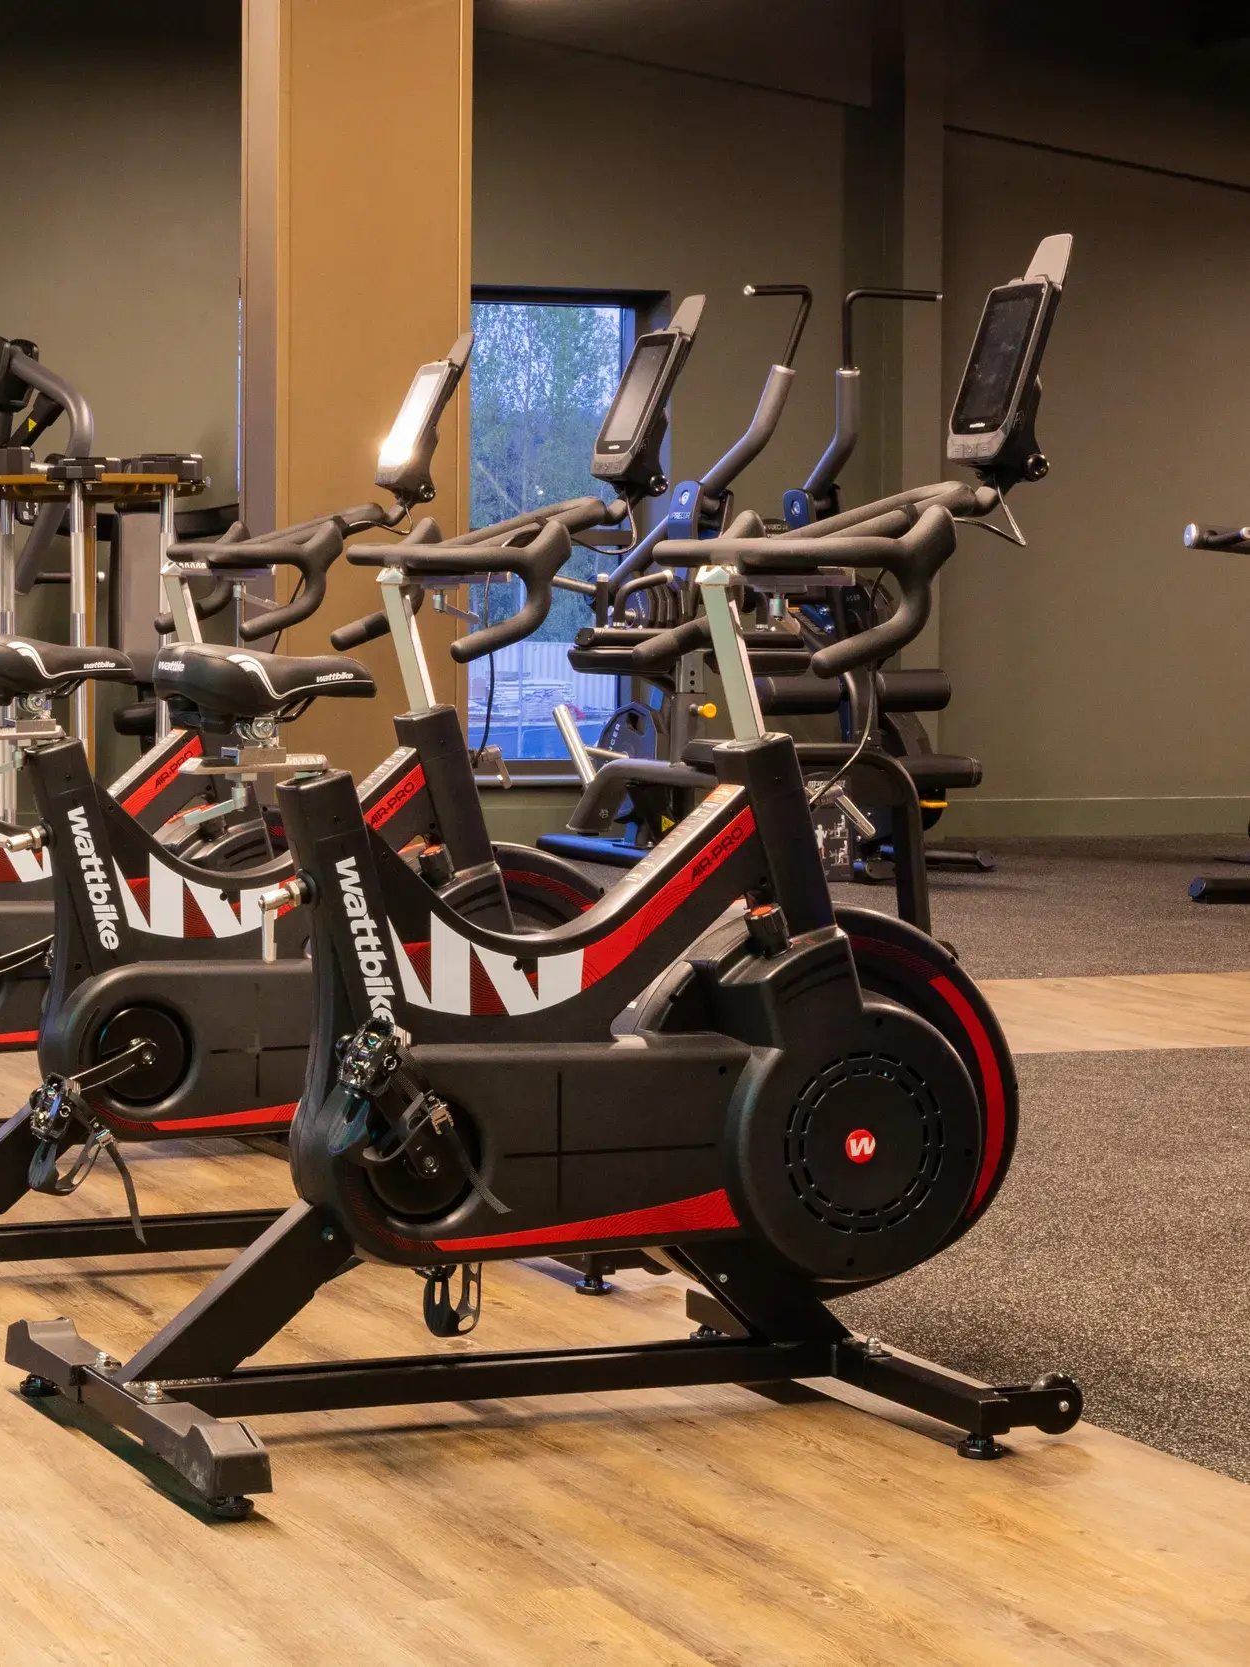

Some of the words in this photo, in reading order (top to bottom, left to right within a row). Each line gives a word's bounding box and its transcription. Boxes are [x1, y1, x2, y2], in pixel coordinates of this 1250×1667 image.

[316, 672, 354, 683] wattbike
[370, 781, 415, 826] AIR-PRO
[67, 805, 120, 950] wattbike
[691, 826, 744, 882] AIR-PRO
